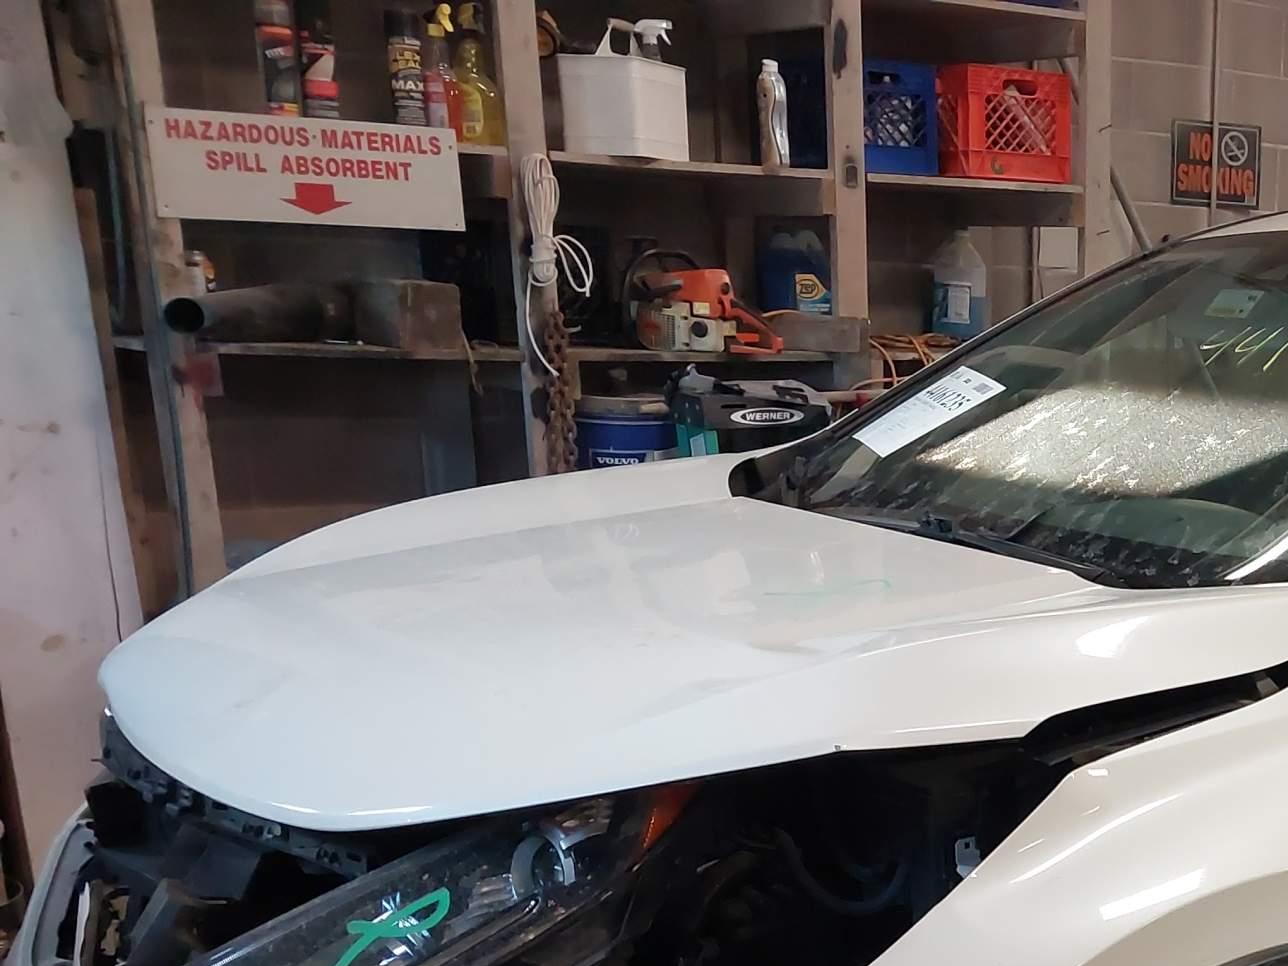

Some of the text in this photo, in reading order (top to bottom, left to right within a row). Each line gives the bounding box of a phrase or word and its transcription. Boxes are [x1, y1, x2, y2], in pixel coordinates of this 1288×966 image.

[391, 79, 424, 91] MAX
[164, 118, 309, 146] HAZARDOUS
[320, 128, 442, 155] MATERIALS
[1189, 131, 1212, 161] NO
[205, 151, 412, 181] SPILL ABSORBENT
[745, 411, 790, 421] WERNER
[596, 456, 639, 465] VOLVO
